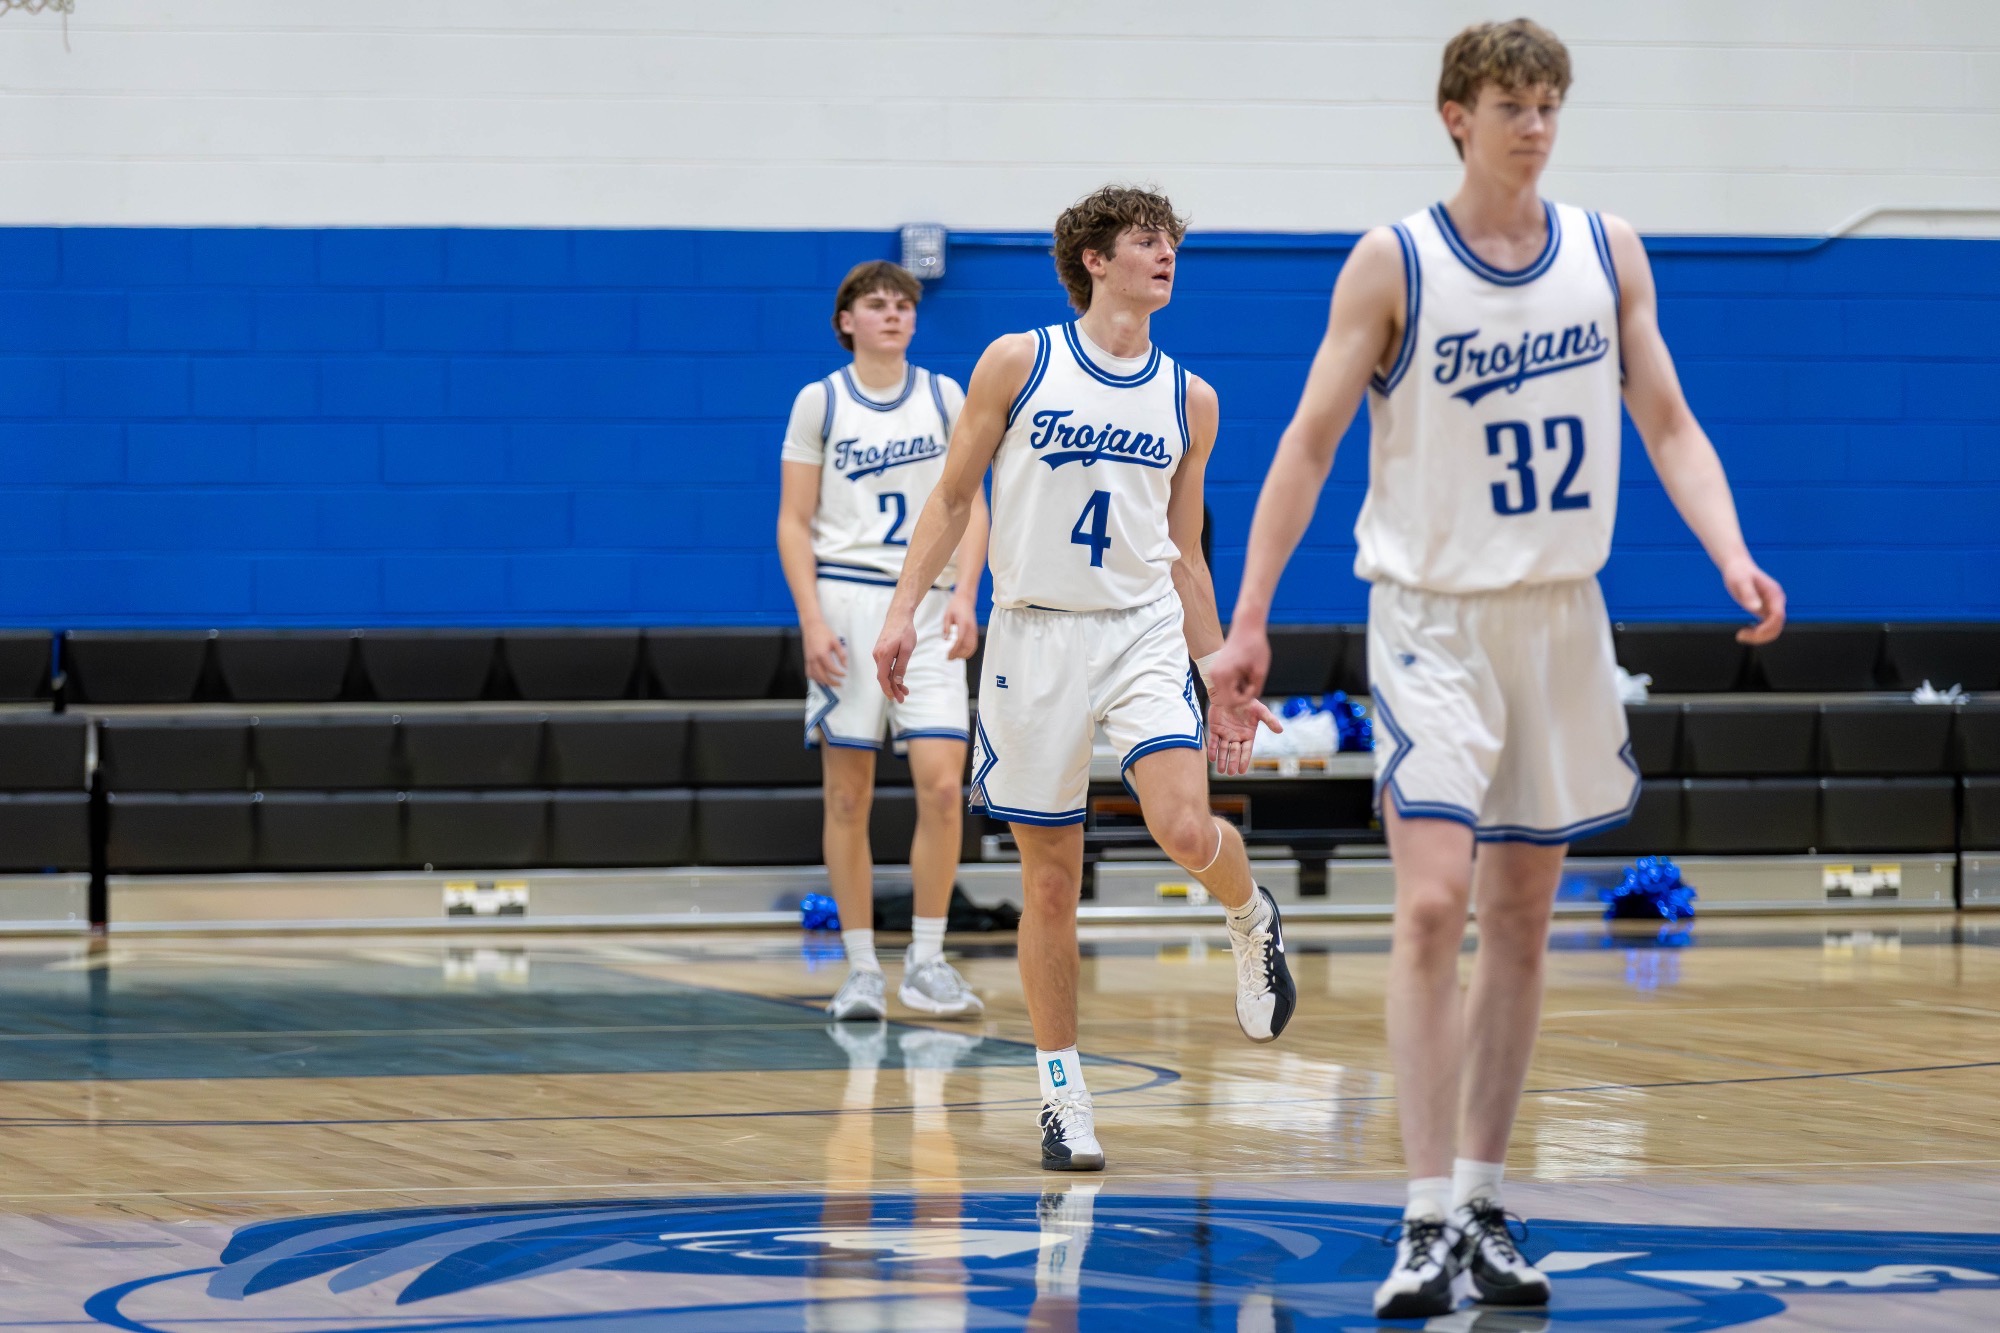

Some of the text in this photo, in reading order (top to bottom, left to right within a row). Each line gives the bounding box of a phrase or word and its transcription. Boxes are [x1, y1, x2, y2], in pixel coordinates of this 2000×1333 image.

[1433, 321, 1610, 404] Trojans
[834, 434, 946, 480] Trojans
[1030, 409, 1173, 470] Trojans
[1484, 415, 1592, 517] 32
[878, 492, 908, 546] 2
[1070, 489, 1112, 569] 4
